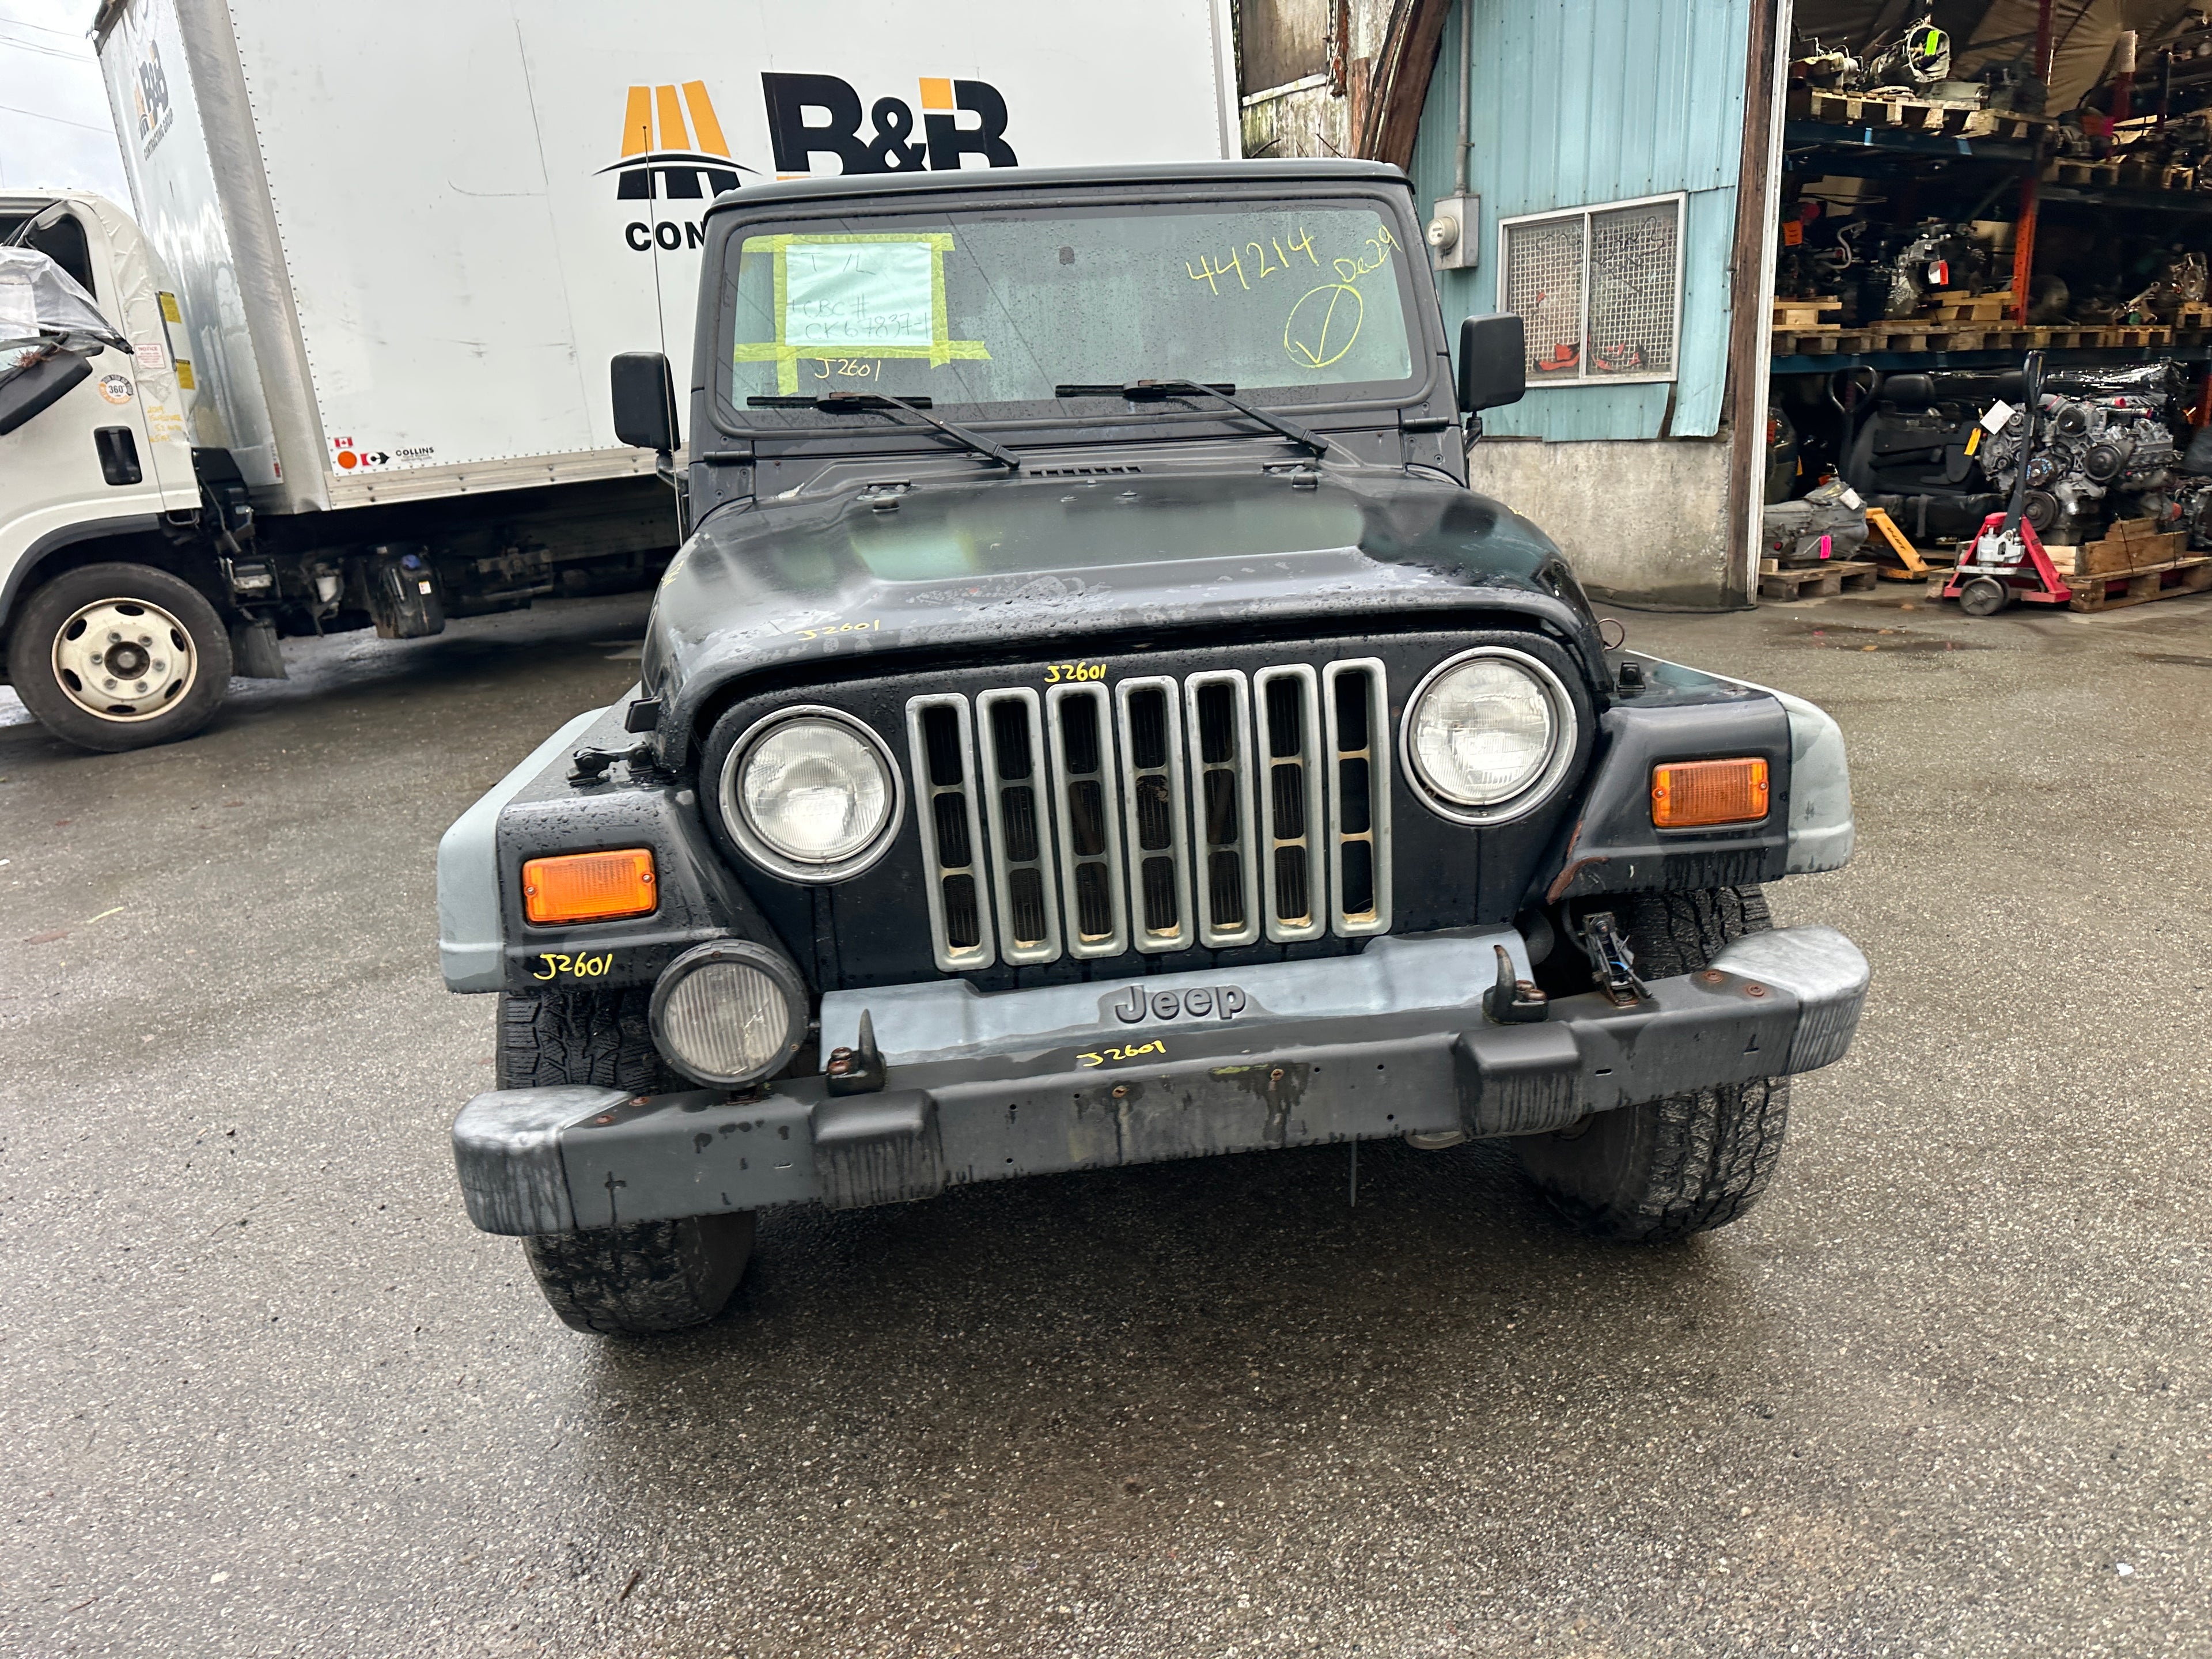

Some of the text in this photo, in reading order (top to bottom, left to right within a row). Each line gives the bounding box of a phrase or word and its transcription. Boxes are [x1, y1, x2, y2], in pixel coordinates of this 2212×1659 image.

[1185, 226, 1319, 296] 44214
[814, 357, 881, 382] J2601
[396, 446, 434, 457] COLLINS
[794, 619, 880, 641] J2601
[1044, 661, 1107, 683] J2601
[533, 952, 613, 980] J2601
[1115, 984, 1247, 1024] Jeep
[1075, 1040, 1166, 1067] J2601
